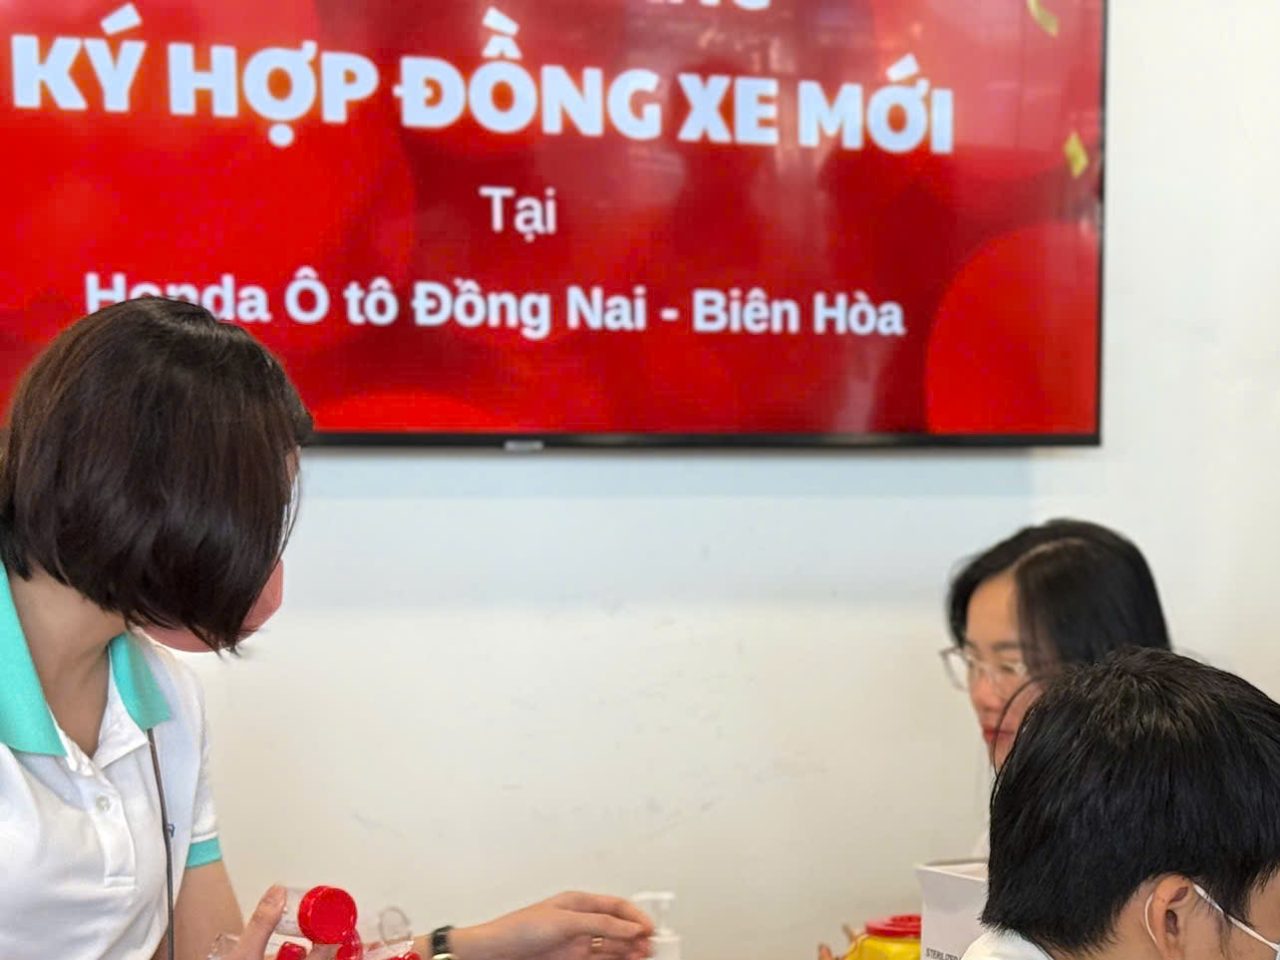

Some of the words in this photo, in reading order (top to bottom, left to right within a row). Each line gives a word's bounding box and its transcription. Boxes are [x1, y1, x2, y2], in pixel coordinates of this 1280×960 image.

[10, 2, 147, 112] KÝ
[167, 40, 379, 148] HỢP
[394, 6, 662, 140] ĐỒNG
[677, 73, 779, 145] XE
[797, 53, 955, 154] MỚI
[479, 186, 557, 242] Tại
[285, 265, 330, 323] Ô
[344, 277, 400, 325] tô
[412, 277, 552, 339] Đồng
[566, 285, 647, 331] Nai
[693, 288, 799, 334] Biên
[814, 291, 905, 336] Hòa
